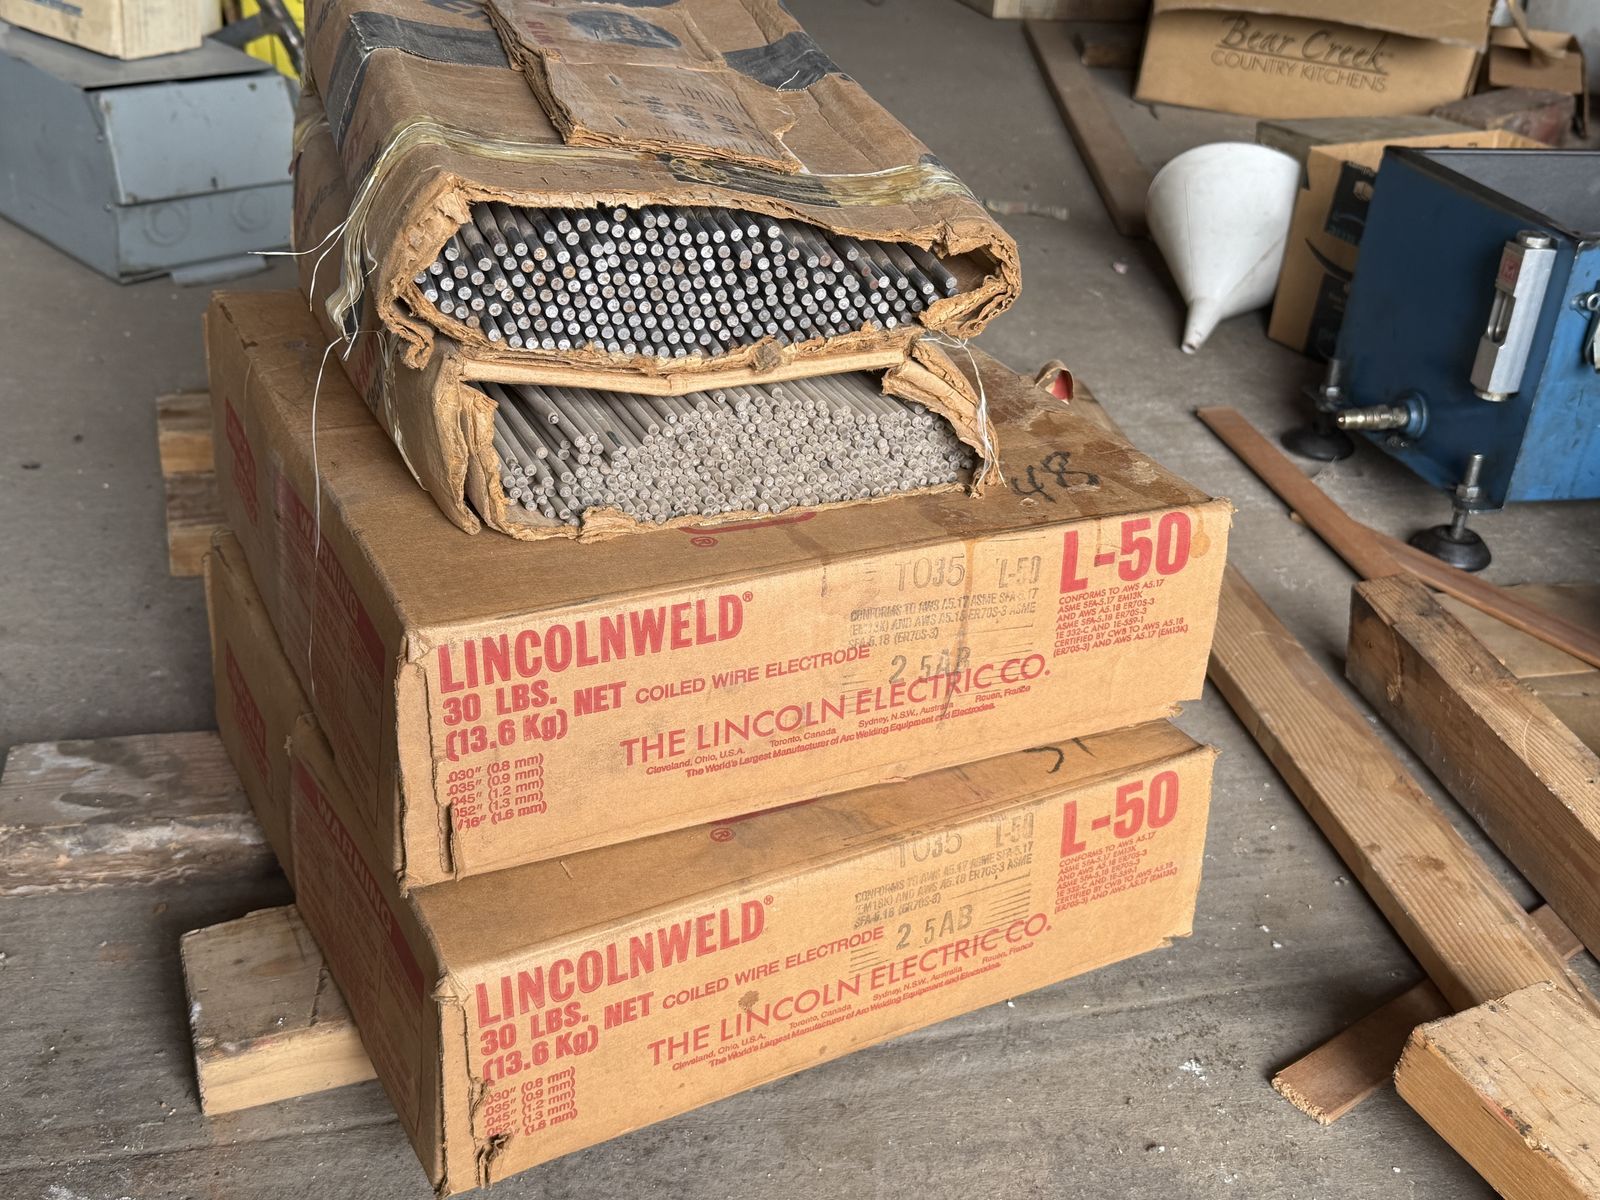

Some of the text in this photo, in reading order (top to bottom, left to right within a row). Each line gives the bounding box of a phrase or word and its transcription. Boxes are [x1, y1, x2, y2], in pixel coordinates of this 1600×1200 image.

[1221, 13, 1390, 74] Bear Creek
[1210, 49, 1388, 93] COUNTRY KITCHENS
[1060, 511, 1192, 595] L-50
[1058, 577, 1164, 605] CONFORMS TO AWS A5.17
[572, 644, 869, 716] NET COILED WIRE ELECTRODE
[889, 653, 906, 685] 2
[441, 677, 557, 727] 30 LBS.
[1003, 684, 1030, 697] France
[619, 650, 1051, 768] THE LINCOLN ELECTRIC CO.
[858, 714, 889, 729] Sydney,
[443, 707, 569, 762] (13.6 Kg)
[685, 765, 703, 778] The
[704, 758, 737, 774] World's
[739, 750, 770, 766] Largest
[772, 738, 828, 758] Manufacturer
[830, 735, 838, 745] of
[839, 732, 854, 743] Arc
[855, 724, 889, 740] Welding
[889, 714, 933, 733] Equipment
[769, 726, 836, 748] Toronto, Canada
[486, 759, 510, 777] (0.8
[513, 751, 544, 771] mm)
[487, 772, 511, 789] (0.9
[514, 764, 544, 782] mm)
[645, 746, 745, 776] Cleveland, Ohio, U.S.A.
[451, 776, 544, 807] 045" (1.2 mm)
[487, 788, 544, 813] (1.3 mm)
[517, 799, 548, 819] mm)
[1060, 770, 1179, 858] L-50
[319, 795, 393, 937] WARNING
[896, 920, 911, 951] 2
[602, 924, 884, 1030] NET COILED WIRE ELECTRODE
[647, 908, 1053, 1067] THE LINCOLN ELECTRIC CO.
[872, 985, 902, 1003] Sydney,
[930, 964, 962, 982] Australia
[478, 997, 589, 1057] 30 LBS.
[789, 1002, 851, 1030] Toronto, Canada
[480, 1021, 600, 1089] (13.6 Kg)
[672, 1049, 715, 1072] Cleveland,
[717, 1040, 738, 1055] Ohio,
[709, 1054, 726, 1068] The
[791, 1013, 844, 1039] Manufacturer
[521, 1087, 544, 1105] (0.9
[546, 1075, 576, 1097] mm)
[547, 1065, 576, 1086] mm)
[521, 1098, 544, 1116] (1.2
[547, 1087, 576, 1107] mm)
[521, 1097, 575, 1127] (1.3 mm)
[549, 1107, 578, 1127] mm)
